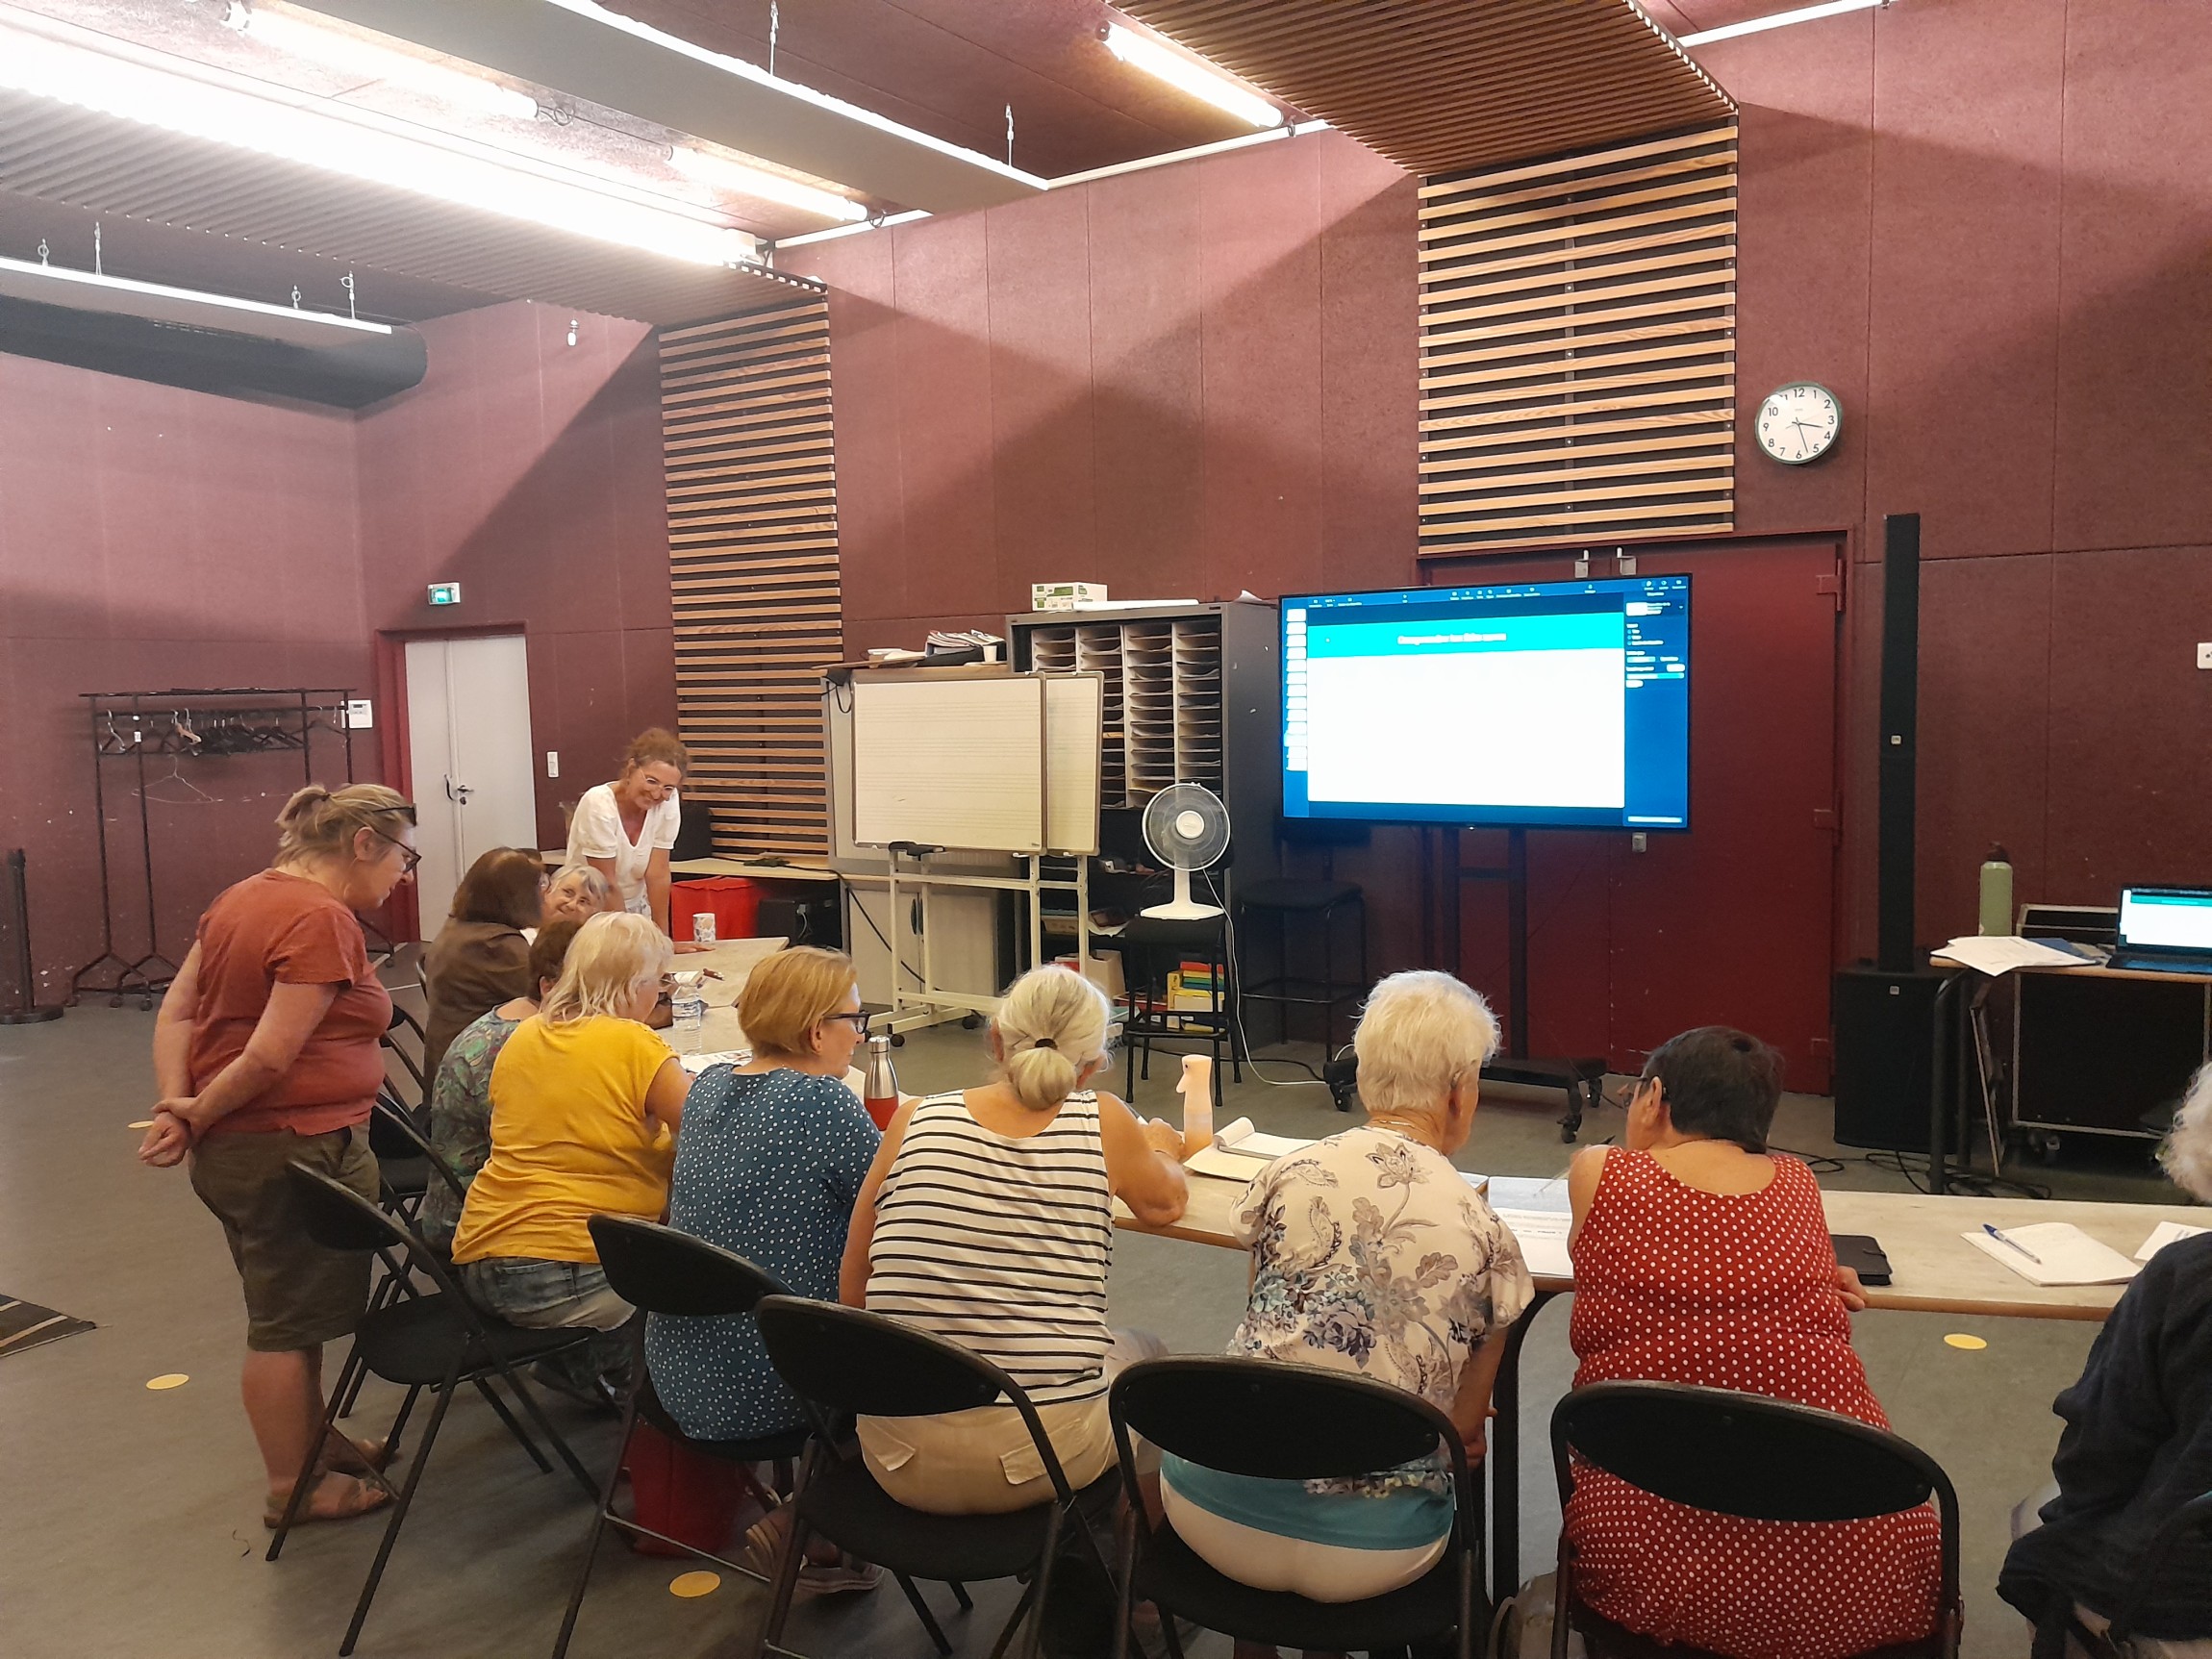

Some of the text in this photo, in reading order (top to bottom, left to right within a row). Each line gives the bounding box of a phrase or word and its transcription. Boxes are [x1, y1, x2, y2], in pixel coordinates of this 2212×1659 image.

[1794, 388, 1805, 398] 12
[1813, 390, 1817, 399] 1
[1823, 399, 1831, 409] 2
[1768, 407, 1778, 416] 10
[1827, 415, 1835, 425] 3
[1823, 431, 1830, 440] 4
[1768, 439, 1774, 447] 8
[1779, 447, 1786, 456] 7
[1813, 443, 1820, 453] 5
[1796, 450, 1802, 459] 6
